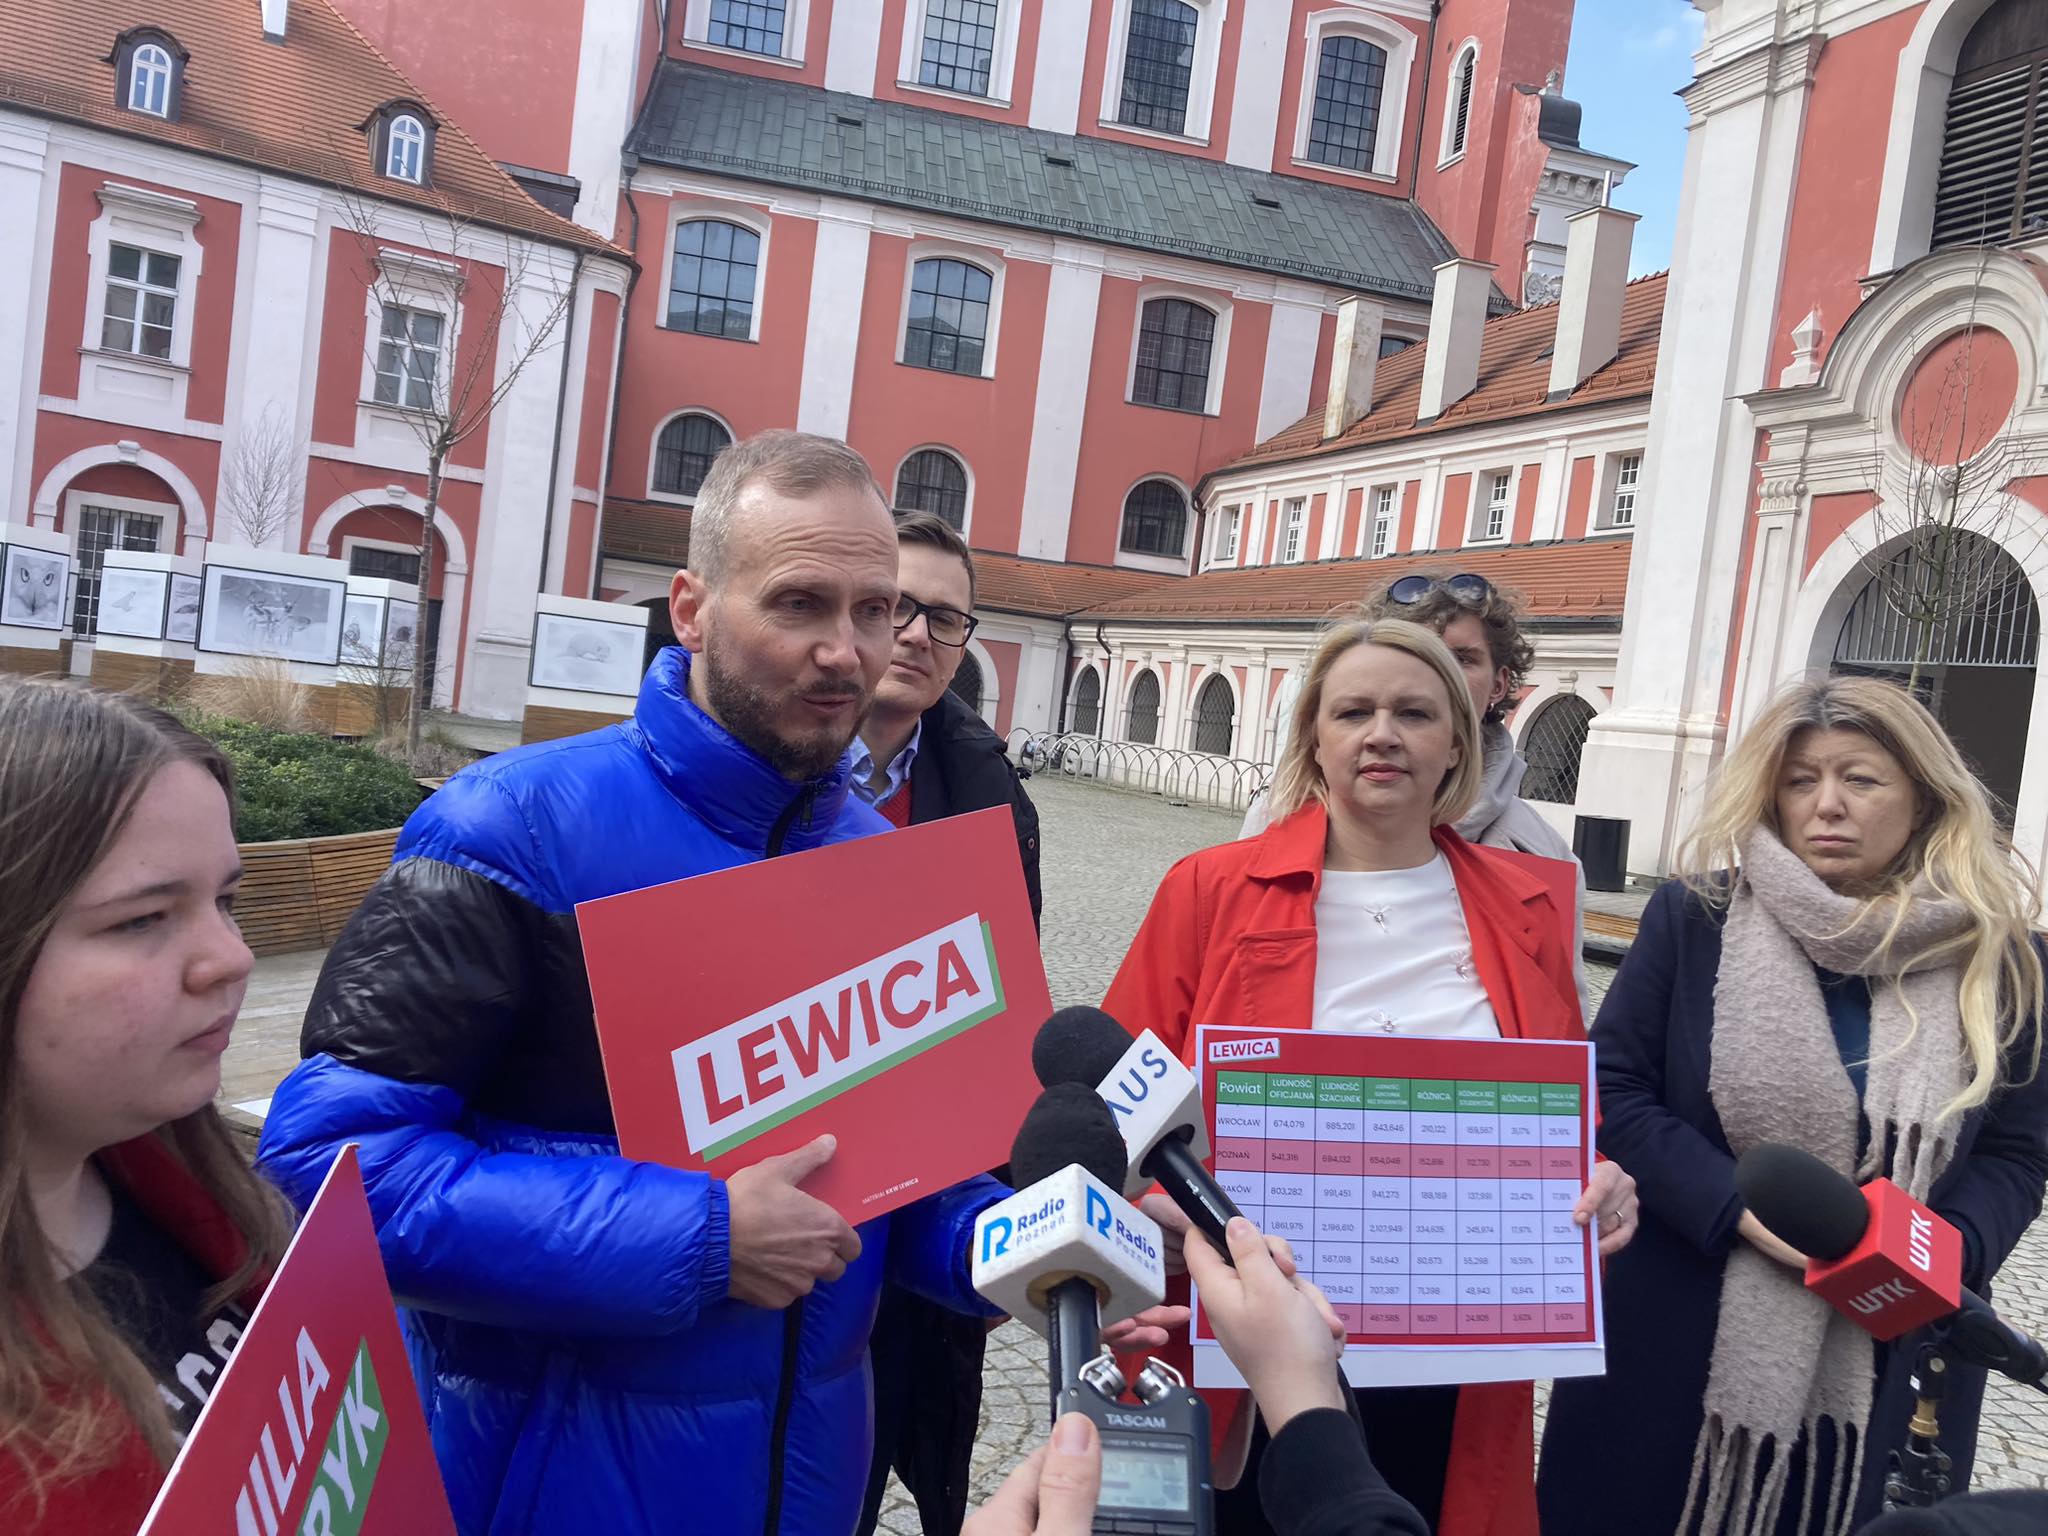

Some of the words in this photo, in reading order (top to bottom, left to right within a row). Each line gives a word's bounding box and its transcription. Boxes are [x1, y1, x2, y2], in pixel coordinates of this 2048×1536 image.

[697, 939, 981, 1126] LEWICA
[1213, 1041, 1275, 1058] LEWICA
[1105, 1048, 1168, 1129] AUS
[1219, 1081, 1262, 1095] Powiat
[1272, 1078, 1312, 1088] LUDNOŚĆ
[1321, 1081, 1360, 1092] LUDNOŚĆ
[1269, 1090, 1315, 1100] OFICJALNA
[1319, 1094, 1361, 1103] SZACUNEK
[1416, 1091, 1451, 1101] RÓŻNICA
[1217, 1117, 1261, 1128] WROCŁAW
[1273, 1119, 1305, 1130] 674,079
[1216, 1150, 1250, 1159] POZNAŃ
[1221, 1184, 1252, 1194] RAKÓW
[1270, 1187, 1303, 1197] 803,282
[1323, 1188, 1351, 1199] 991,451
[1017, 1197, 1065, 1232] Radio
[1016, 1215, 1066, 1248] Poznań
[1271, 1221, 1304, 1231] 1,861,975
[1115, 1217, 1156, 1260] Radio
[1909, 1208, 1932, 1271] WTK
[1115, 1236, 1158, 1275] Poznań
[1322, 1285, 1354, 1295] 729,842
[1848, 1277, 1917, 1314] WTK
[1105, 1413, 1167, 1429] TASCAM
